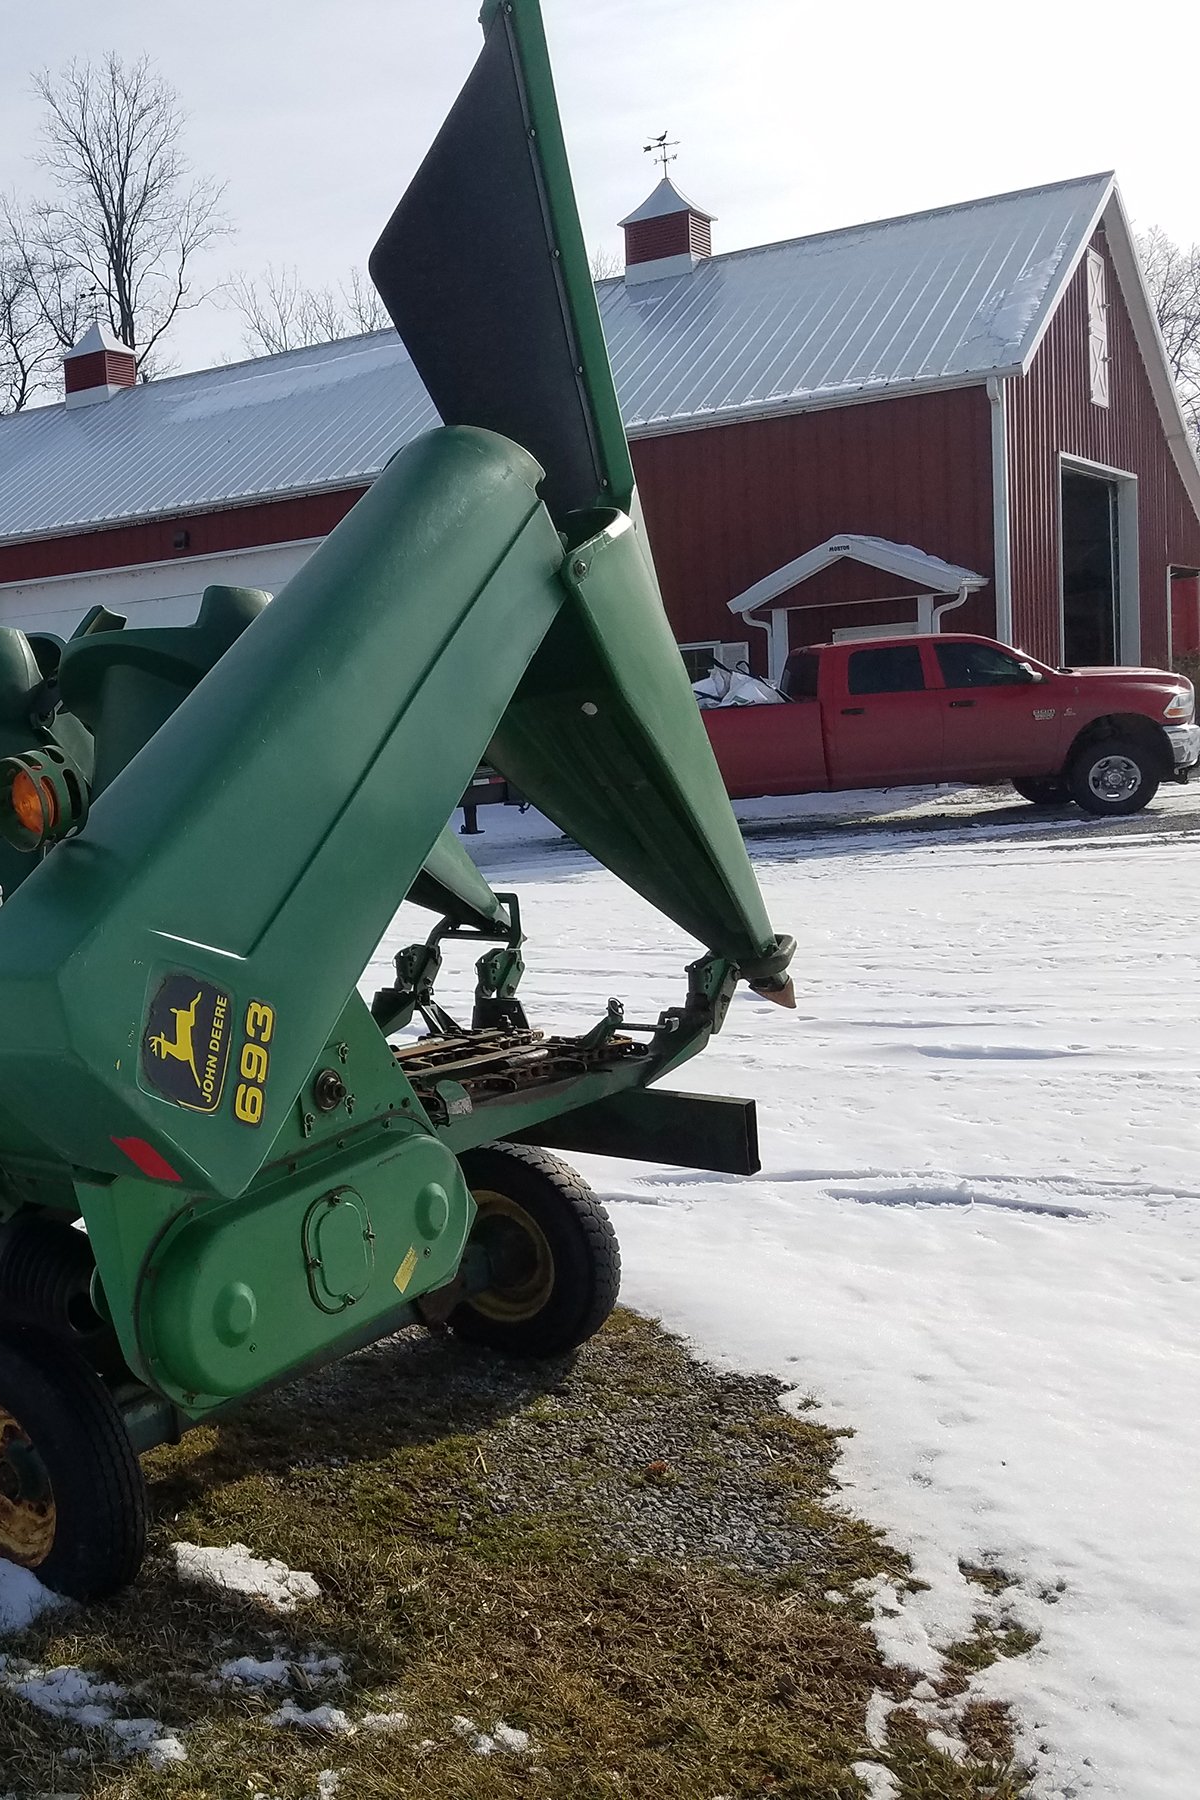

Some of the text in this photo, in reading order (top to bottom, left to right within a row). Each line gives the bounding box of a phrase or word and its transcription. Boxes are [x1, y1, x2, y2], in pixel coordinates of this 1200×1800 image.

[202, 995, 228, 1102] JOHN DEERE
[235, 1001, 274, 1124] 693
